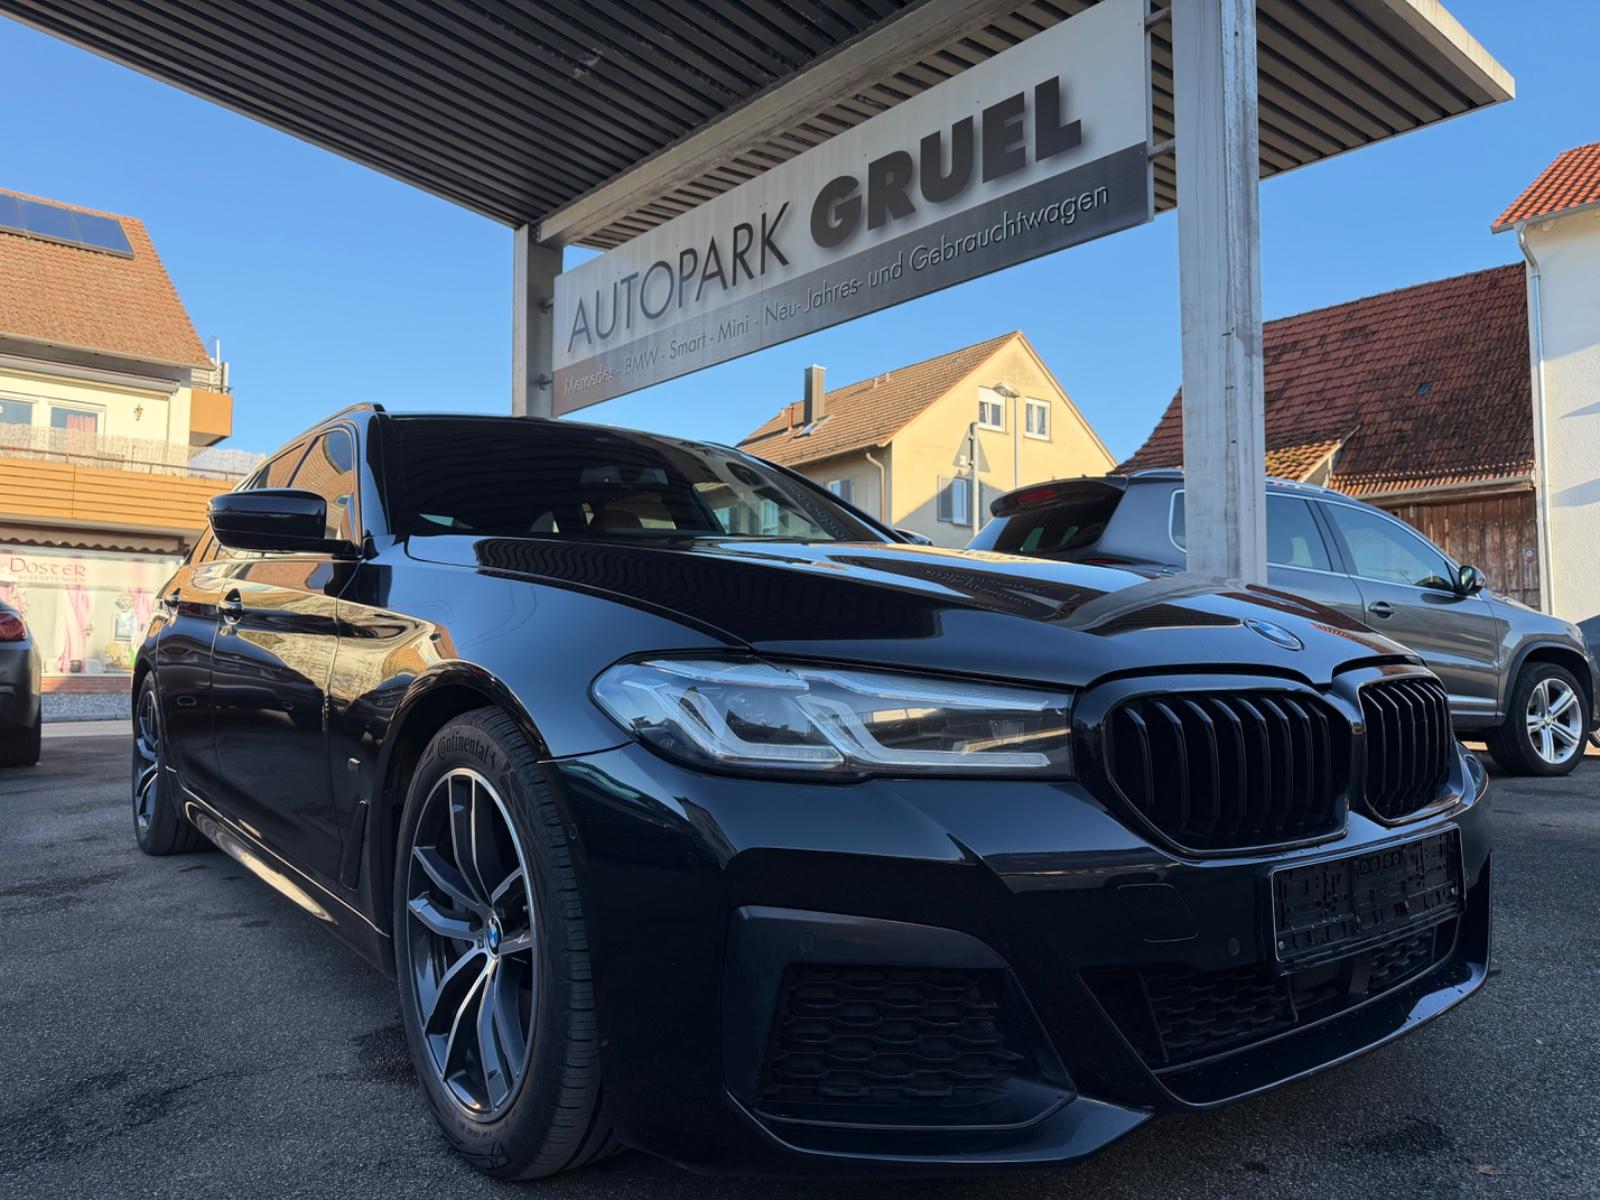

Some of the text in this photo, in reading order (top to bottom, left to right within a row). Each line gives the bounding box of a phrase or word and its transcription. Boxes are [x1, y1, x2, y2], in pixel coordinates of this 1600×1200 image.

[563, 367, 615, 397] Mercedes
[624, 345, 659, 375] BMW
[669, 331, 706, 359] Smart
[717, 315, 749, 343] Mini
[868, 252, 903, 287] und
[909, 185, 1109, 271] Gebrauchtwagen
[567, 75, 1082, 353] AUTOPARK GRUEL
[437, 730, 490, 764] Continental
